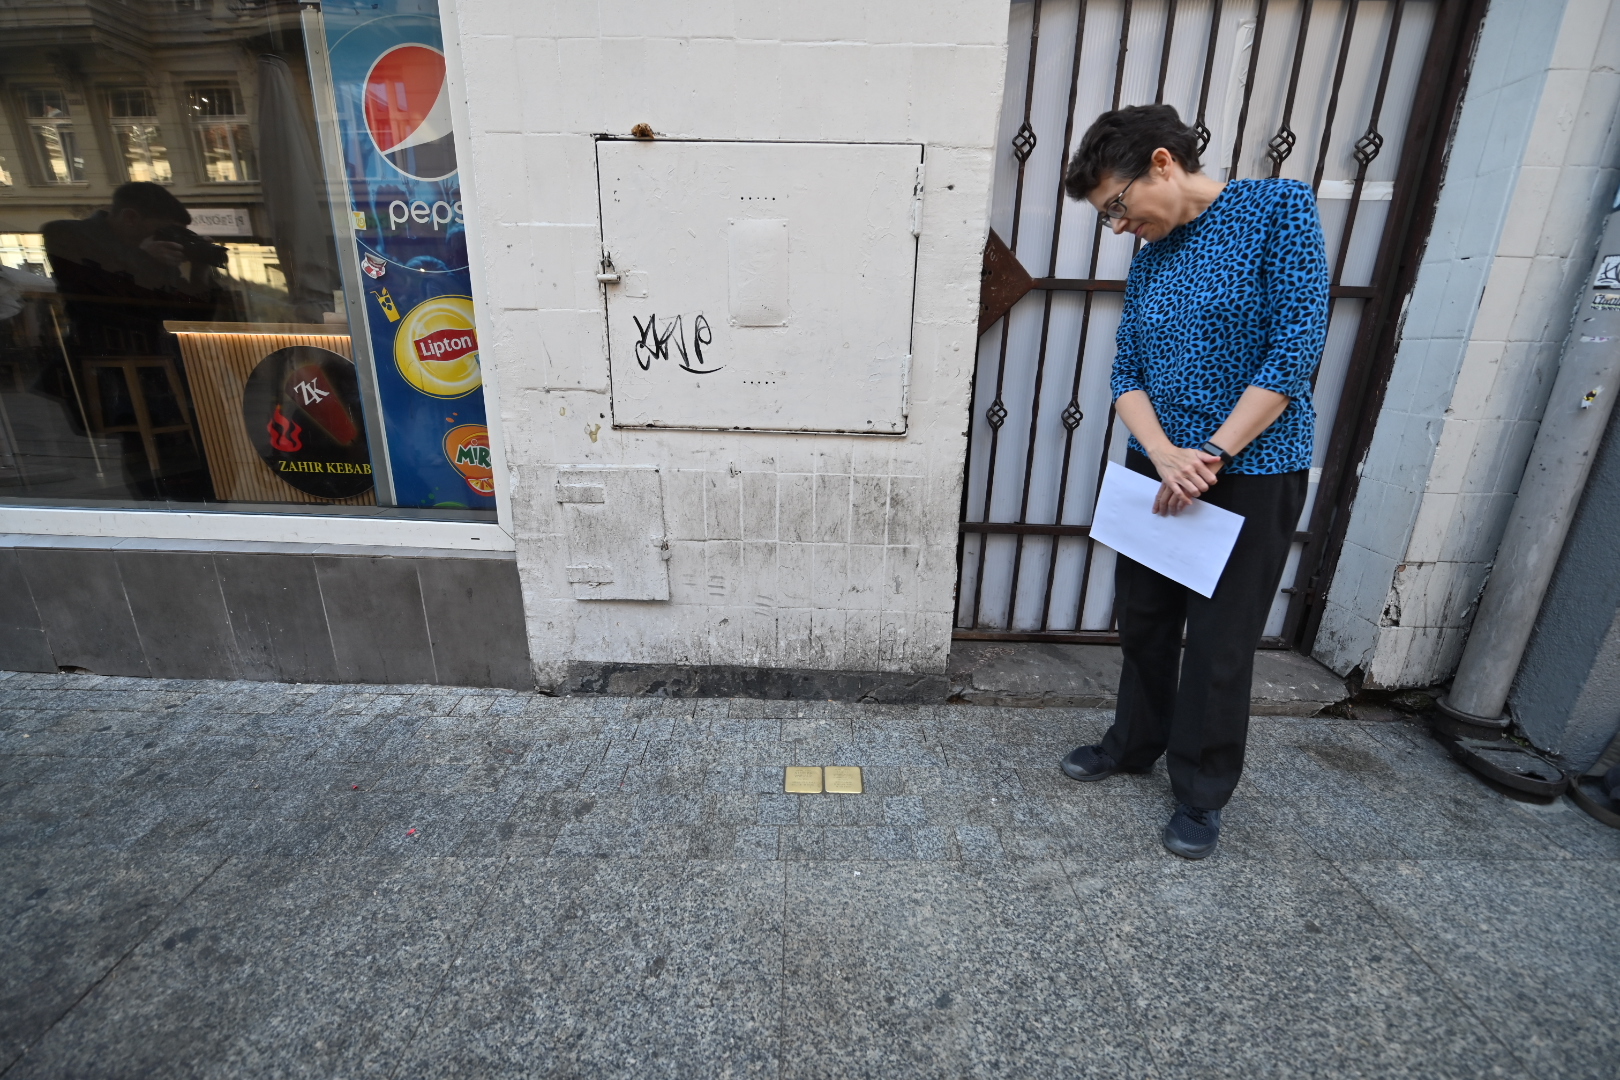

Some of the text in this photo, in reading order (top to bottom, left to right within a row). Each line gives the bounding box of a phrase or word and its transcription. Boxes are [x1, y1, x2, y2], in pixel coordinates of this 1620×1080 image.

[420, 335, 472, 358] Lipton
[293, 377, 330, 406] ZK
[278, 460, 372, 475] ZAHIR KEBAB
[455, 443, 492, 469] MIR
